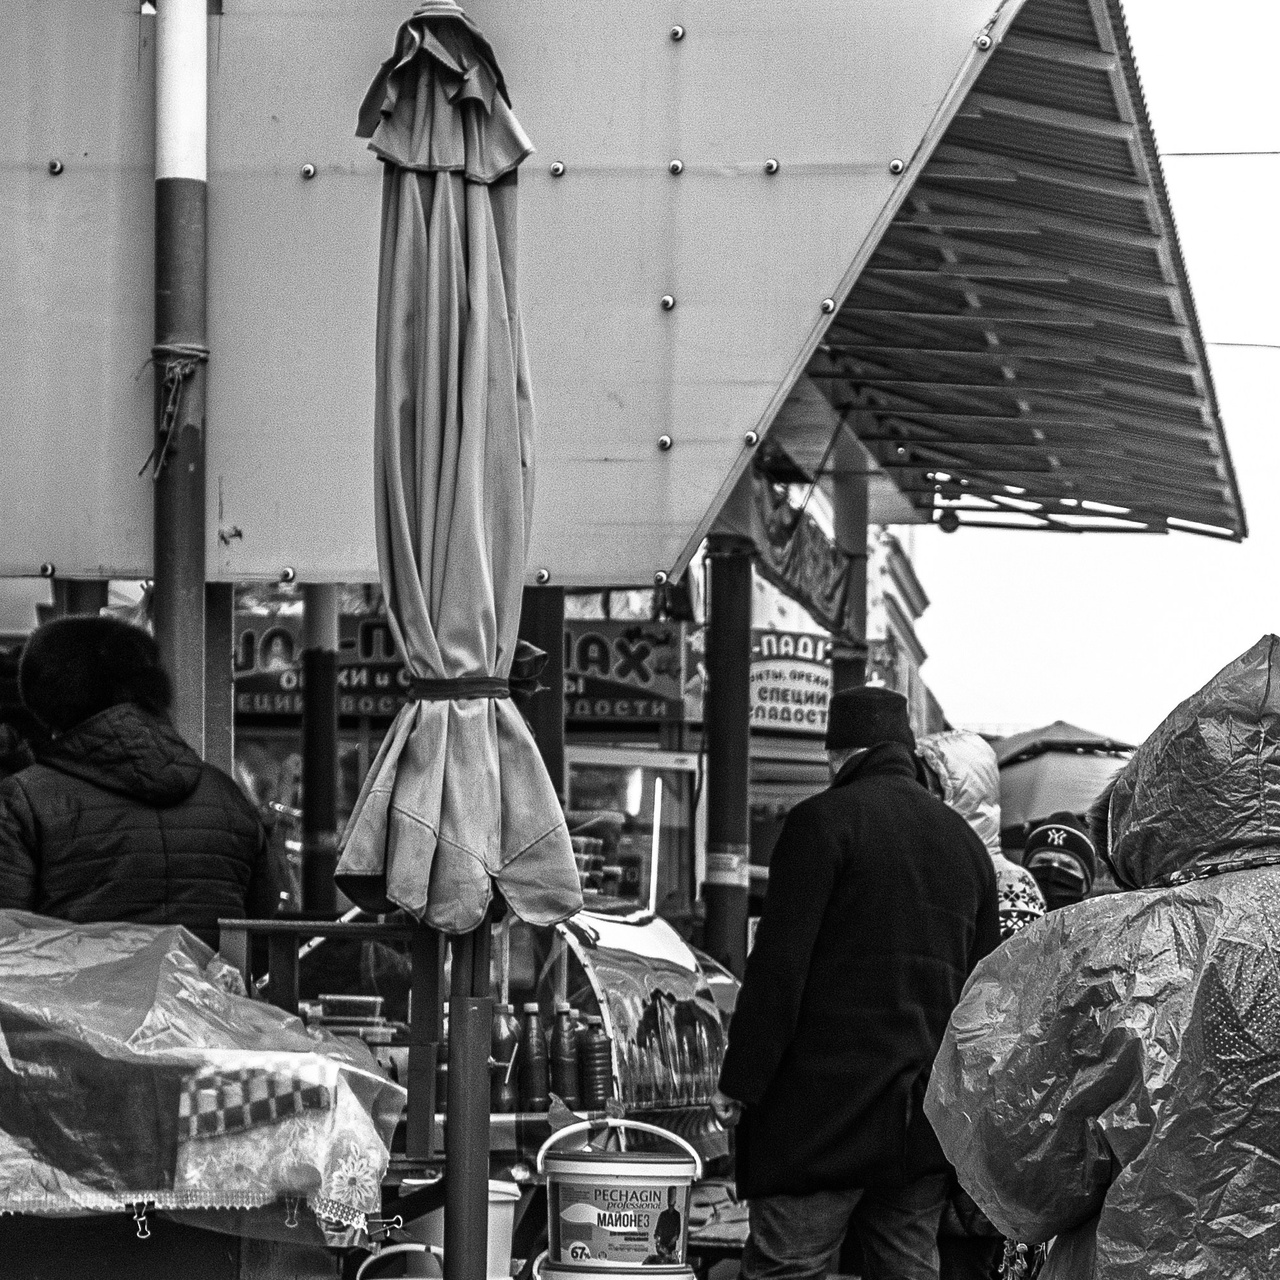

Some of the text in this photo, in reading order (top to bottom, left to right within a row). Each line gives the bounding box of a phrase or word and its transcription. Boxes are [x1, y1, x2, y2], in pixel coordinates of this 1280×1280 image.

[594, 1189, 661, 1201] PECHAGIN
[607, 1201, 661, 1210] professional
[597, 1211, 650, 1227] МАЙОНЕЗ
